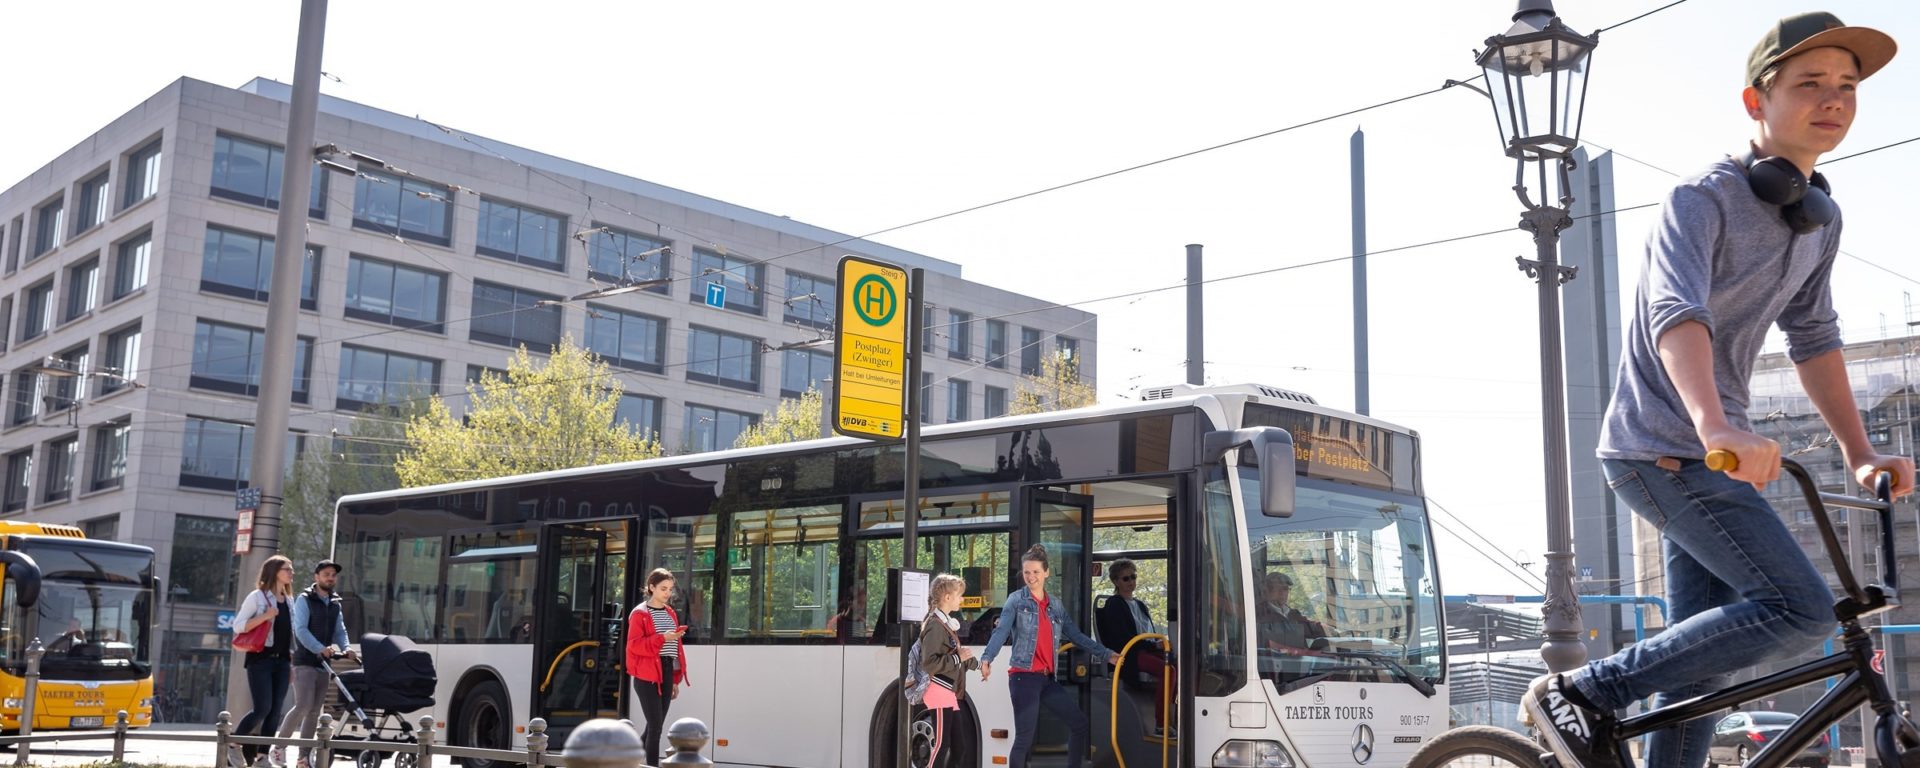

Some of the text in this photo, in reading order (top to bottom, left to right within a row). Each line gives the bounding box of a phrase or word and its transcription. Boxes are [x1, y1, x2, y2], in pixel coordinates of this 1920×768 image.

[881, 268, 898, 280] Steig
[711, 286, 722, 305] T
[855, 340, 891, 355] Postplatz
[852, 352, 893, 368] (Zwinger)
[866, 373, 901, 386] Umleitungen
[850, 417, 867, 427] DVB
[1318, 447, 1370, 472] Postplatz
[43, 690, 105, 699] TAETER TOURS
[1284, 705, 1374, 720] TAETER TOURS
[1400, 715, 1430, 726] 900 157-7
